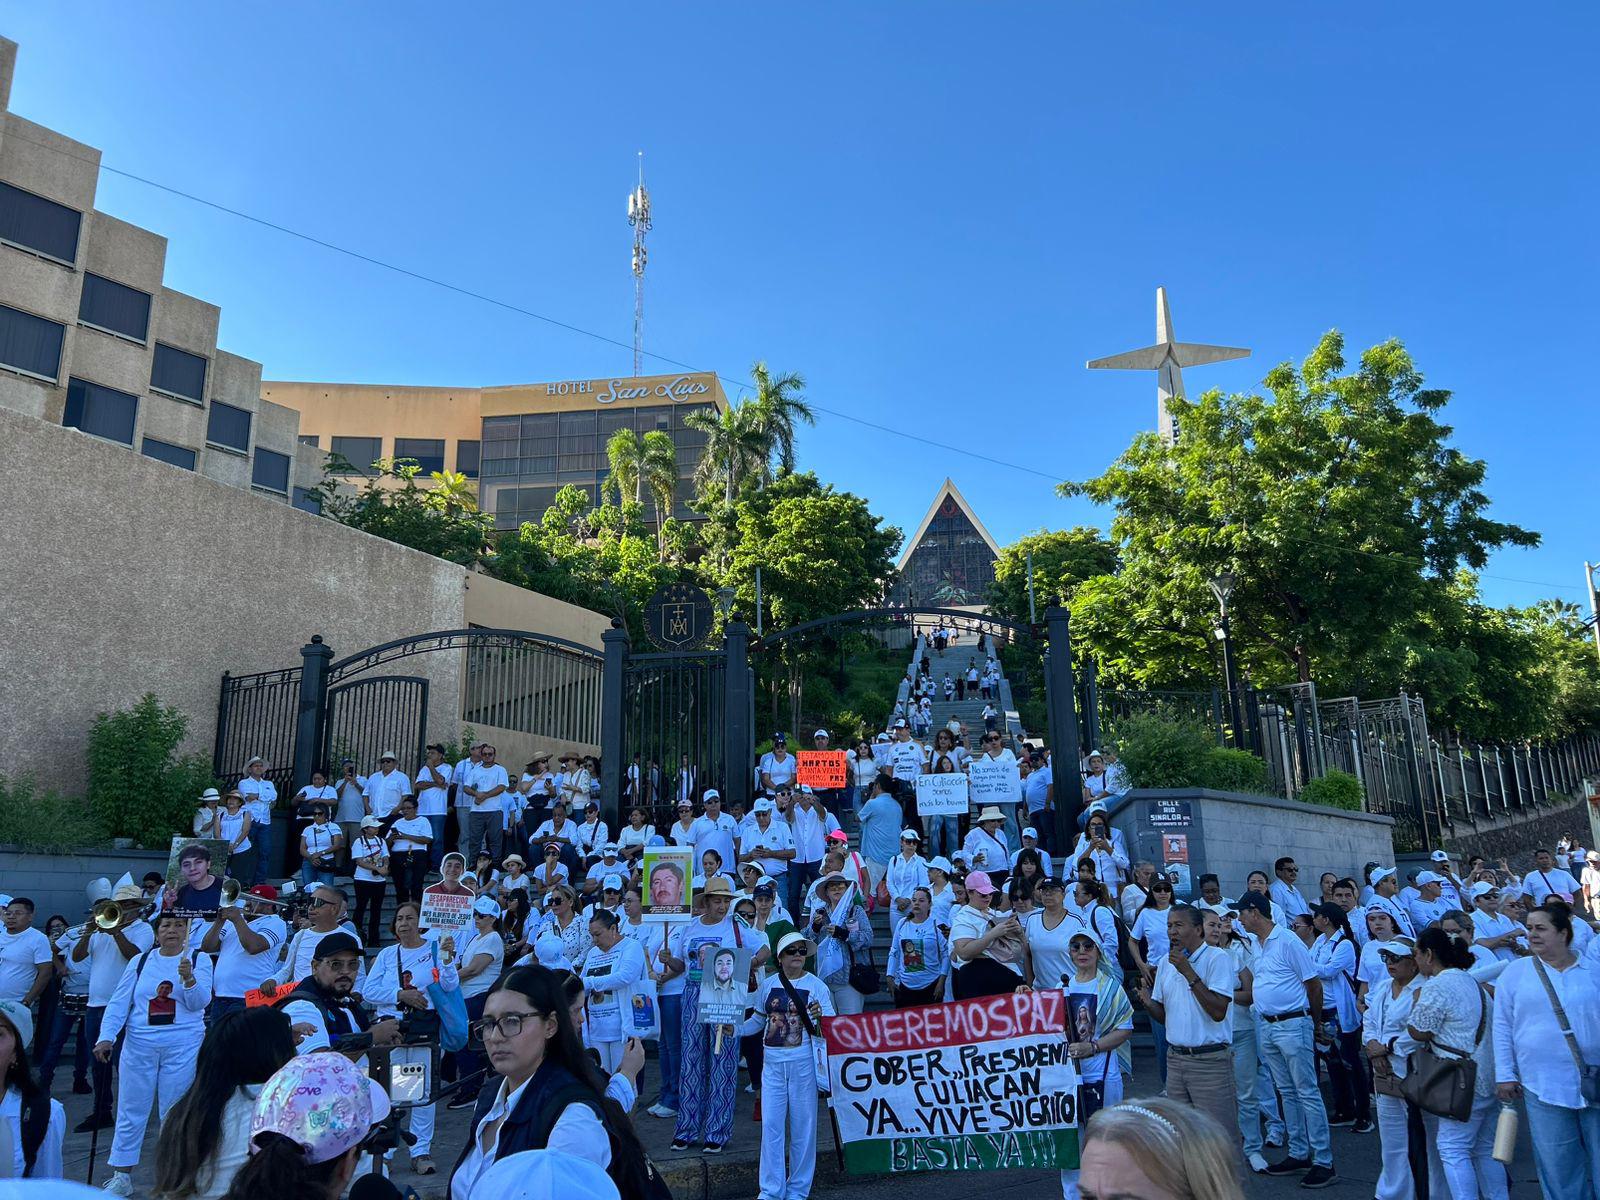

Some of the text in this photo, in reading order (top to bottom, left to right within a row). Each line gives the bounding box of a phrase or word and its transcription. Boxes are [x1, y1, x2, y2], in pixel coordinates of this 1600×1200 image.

[546, 376, 709, 404] HOTEL San Luis
[1012, 991, 1063, 1034] PAZ
[914, 1068, 1041, 1108] CULIACAN
[890, 1136, 985, 1172] BASTA
